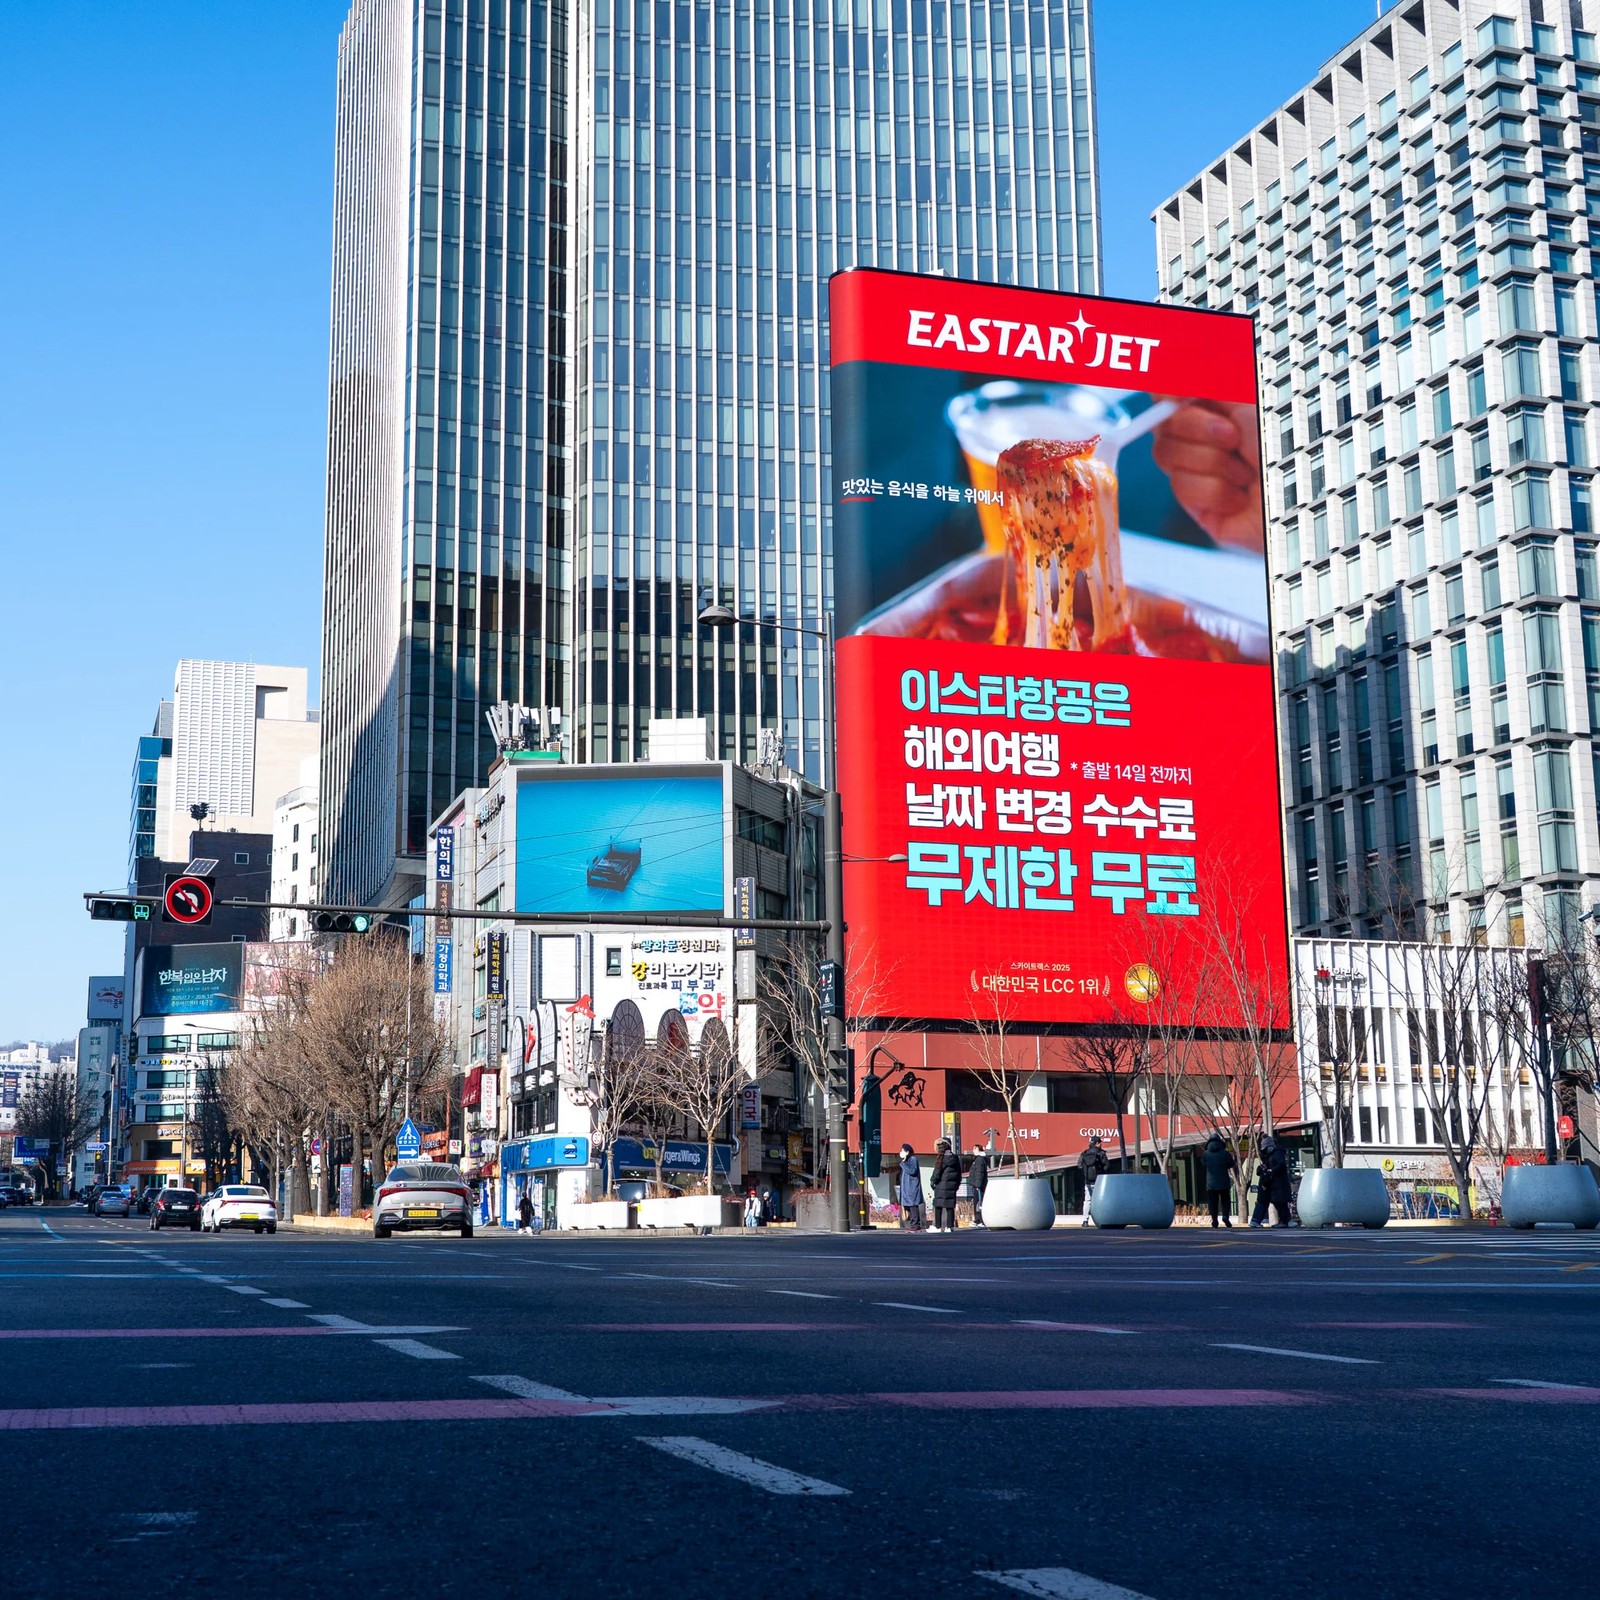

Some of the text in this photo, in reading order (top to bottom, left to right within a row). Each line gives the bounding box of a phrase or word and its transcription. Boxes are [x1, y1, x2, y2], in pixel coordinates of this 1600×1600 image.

[907, 310, 1160, 372] EASTAR JET
[842, 478, 1004, 506] 맛있는 음식을 하늘 위에서
[900, 669, 1131, 727] 이스타항공은
[903, 724, 1061, 778] 해외여행
[1081, 761, 1192, 785] 출발 14일 전까지
[905, 782, 1197, 841] 날짜 변경 수수료
[438, 837, 451, 878] 한의원
[905, 841, 1200, 916] 무제한 무료
[438, 945, 449, 991] 가정의학과
[631, 961, 724, 981] 강비뇨기과
[982, 975, 1039, 993] 대한민국
[1043, 977, 1074, 994] LCC
[1078, 978, 1099, 995] 1위
[1010, 962, 1070, 972] 스카이트랙스 2025
[744, 1090, 758, 1122] 약국
[1079, 1128, 1120, 1137] GODIVA
